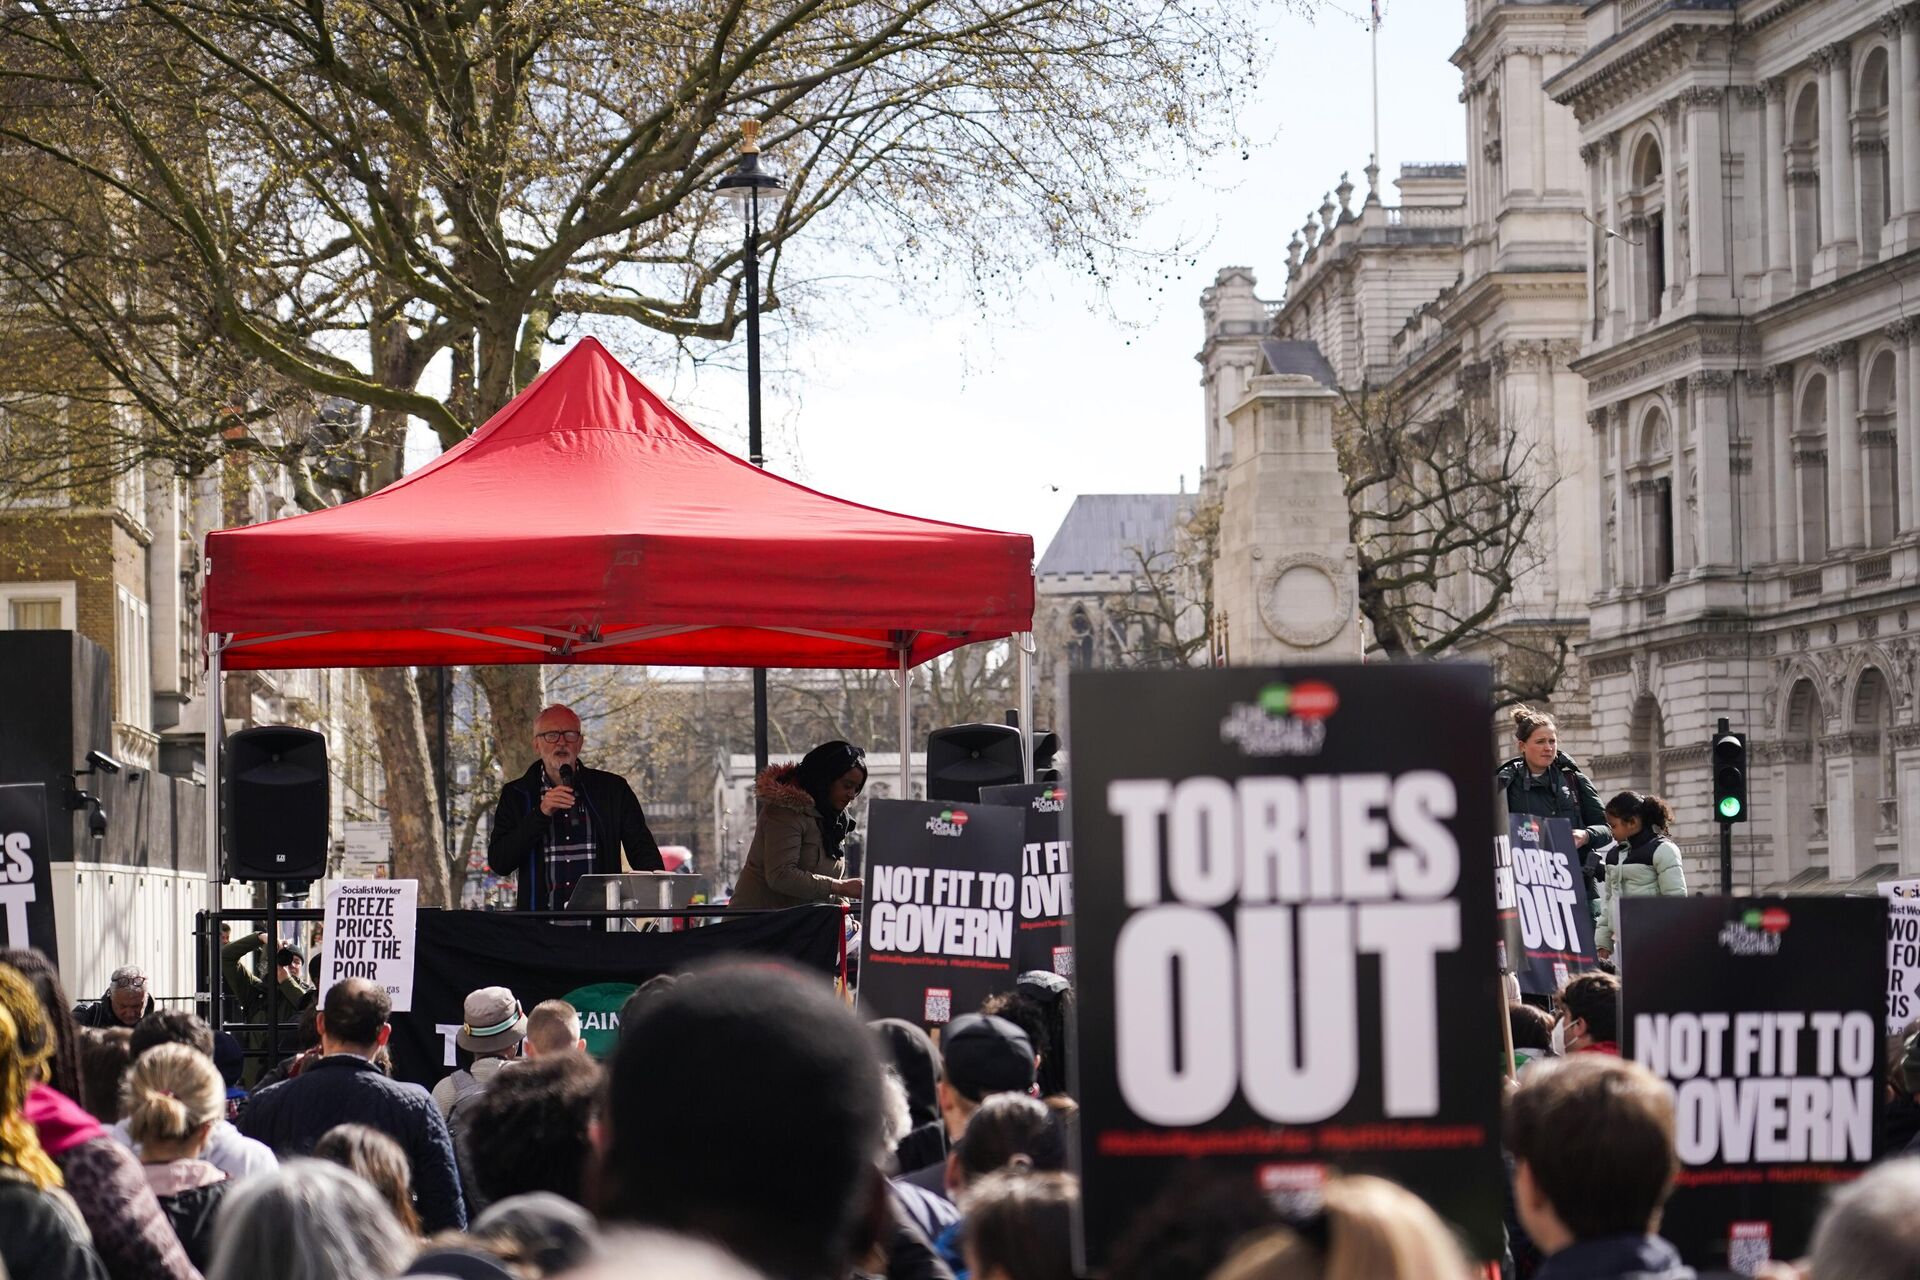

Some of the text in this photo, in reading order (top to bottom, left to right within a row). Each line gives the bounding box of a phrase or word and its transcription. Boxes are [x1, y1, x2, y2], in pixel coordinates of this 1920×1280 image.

[1108, 770, 1460, 908] TORIES
[342, 886, 402, 895] Socialist Worker
[872, 865, 1015, 910] NOT FIT TO
[337, 897, 395, 917] FREEZE
[1516, 883, 1581, 953] OUT
[336, 918, 396, 940] PRICES,
[869, 901, 1014, 959] GOVERN
[334, 939, 401, 960] NOT THE
[333, 960, 378, 981] POOR
[386, 986, 400, 996] gas
[1114, 899, 1461, 1126] OUT
[1634, 1010, 1875, 1079] NOT FIT TO
